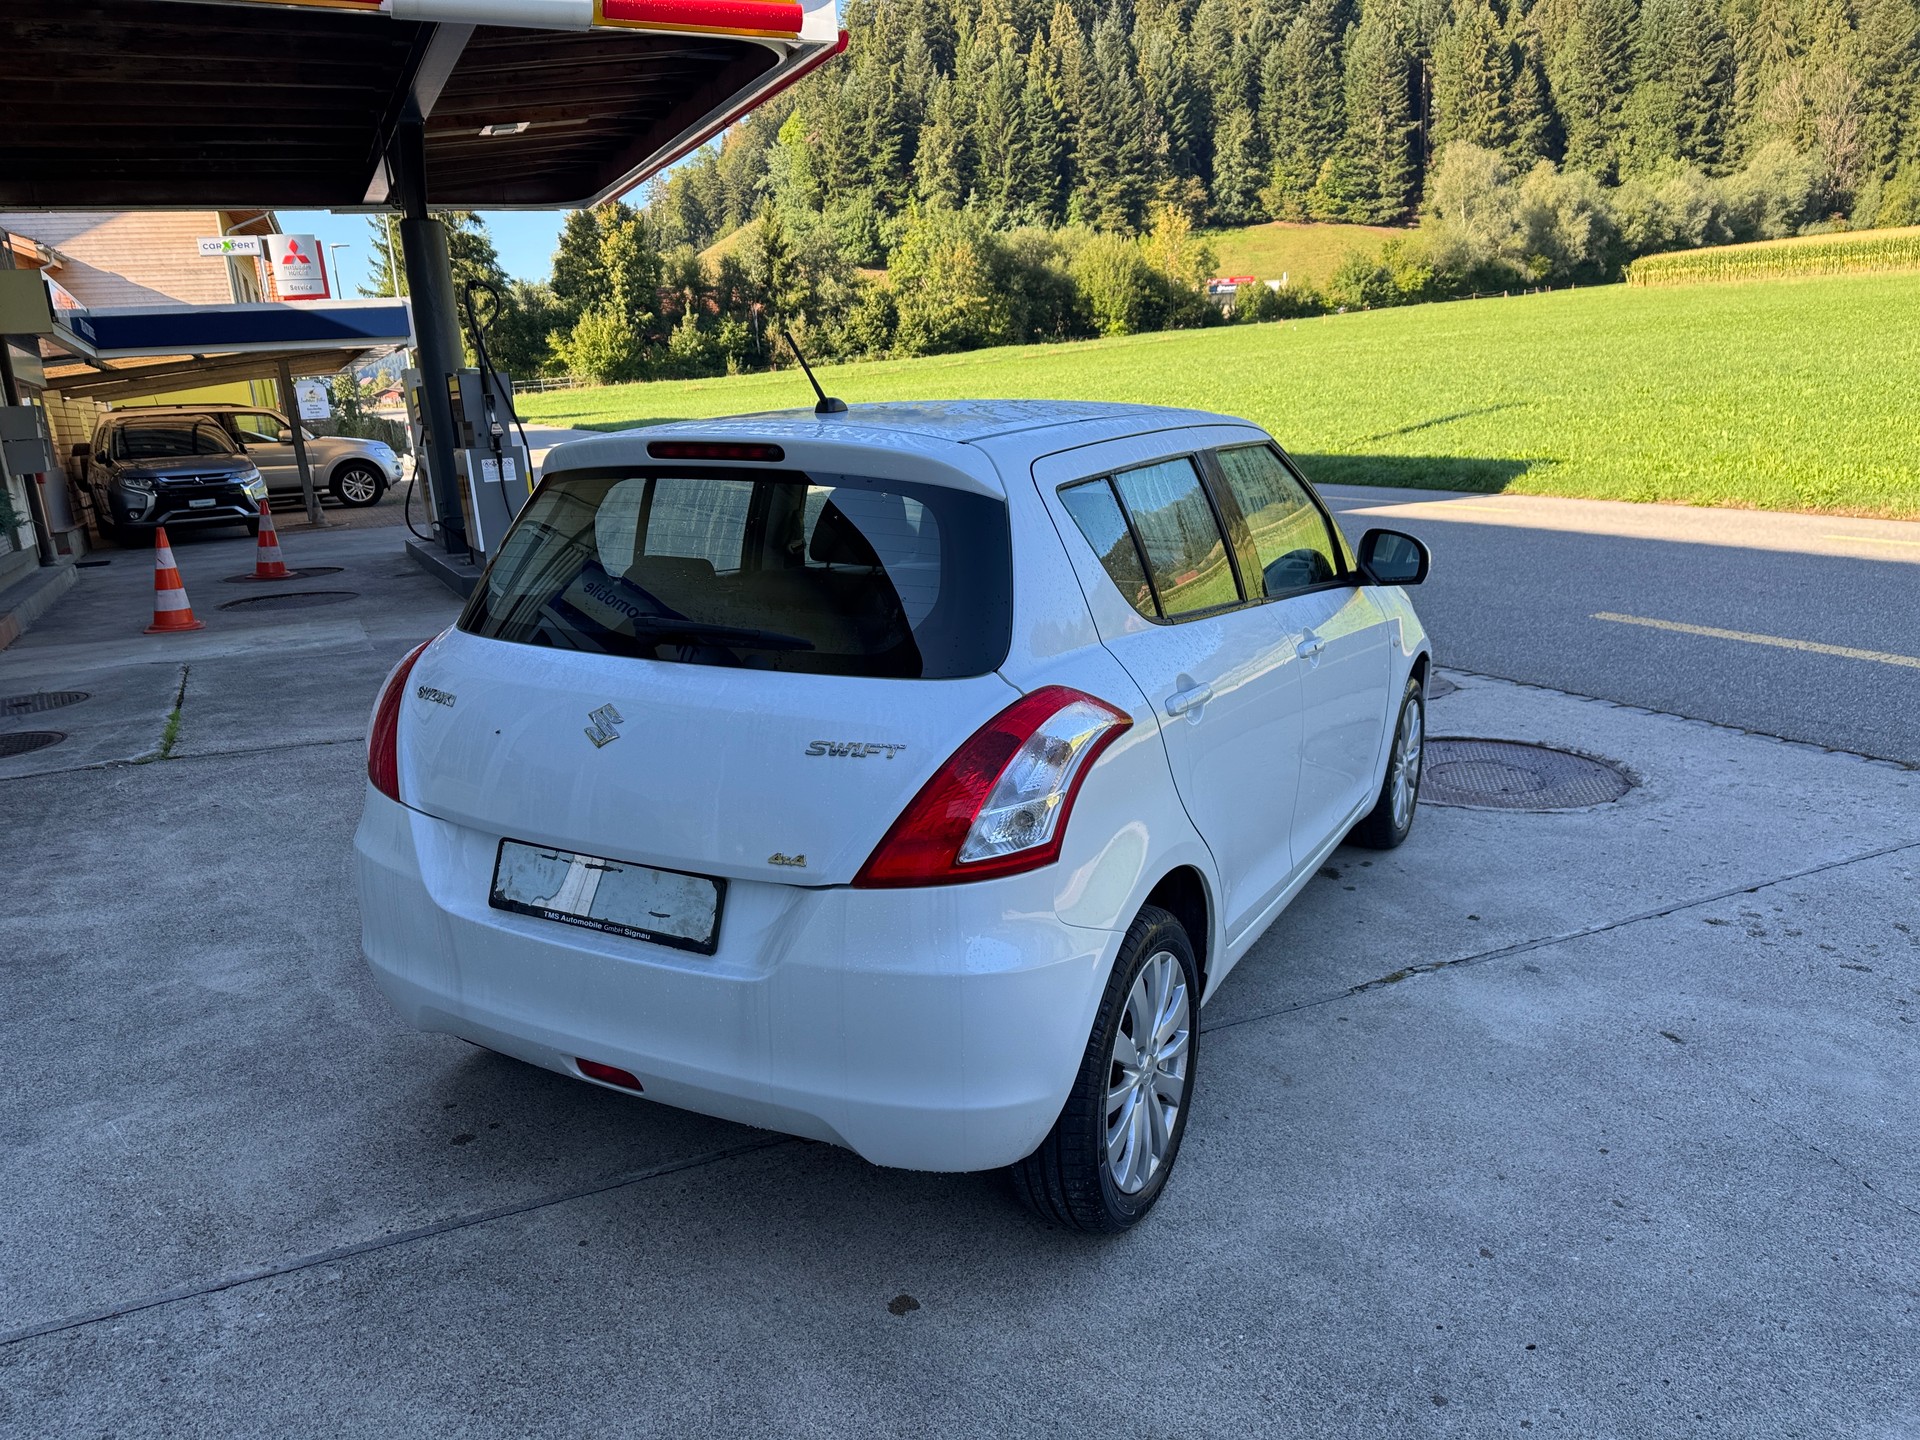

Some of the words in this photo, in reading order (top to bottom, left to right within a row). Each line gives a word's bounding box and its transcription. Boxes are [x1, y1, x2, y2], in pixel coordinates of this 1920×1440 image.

[417, 685, 457, 708] SUZUKI
[805, 740, 907, 759] SWIFT
[543, 910, 560, 920] TMS
[560, 915, 603, 929] Automobile
[603, 924, 624, 934] GmbH
[624, 928, 651, 940] Signau
